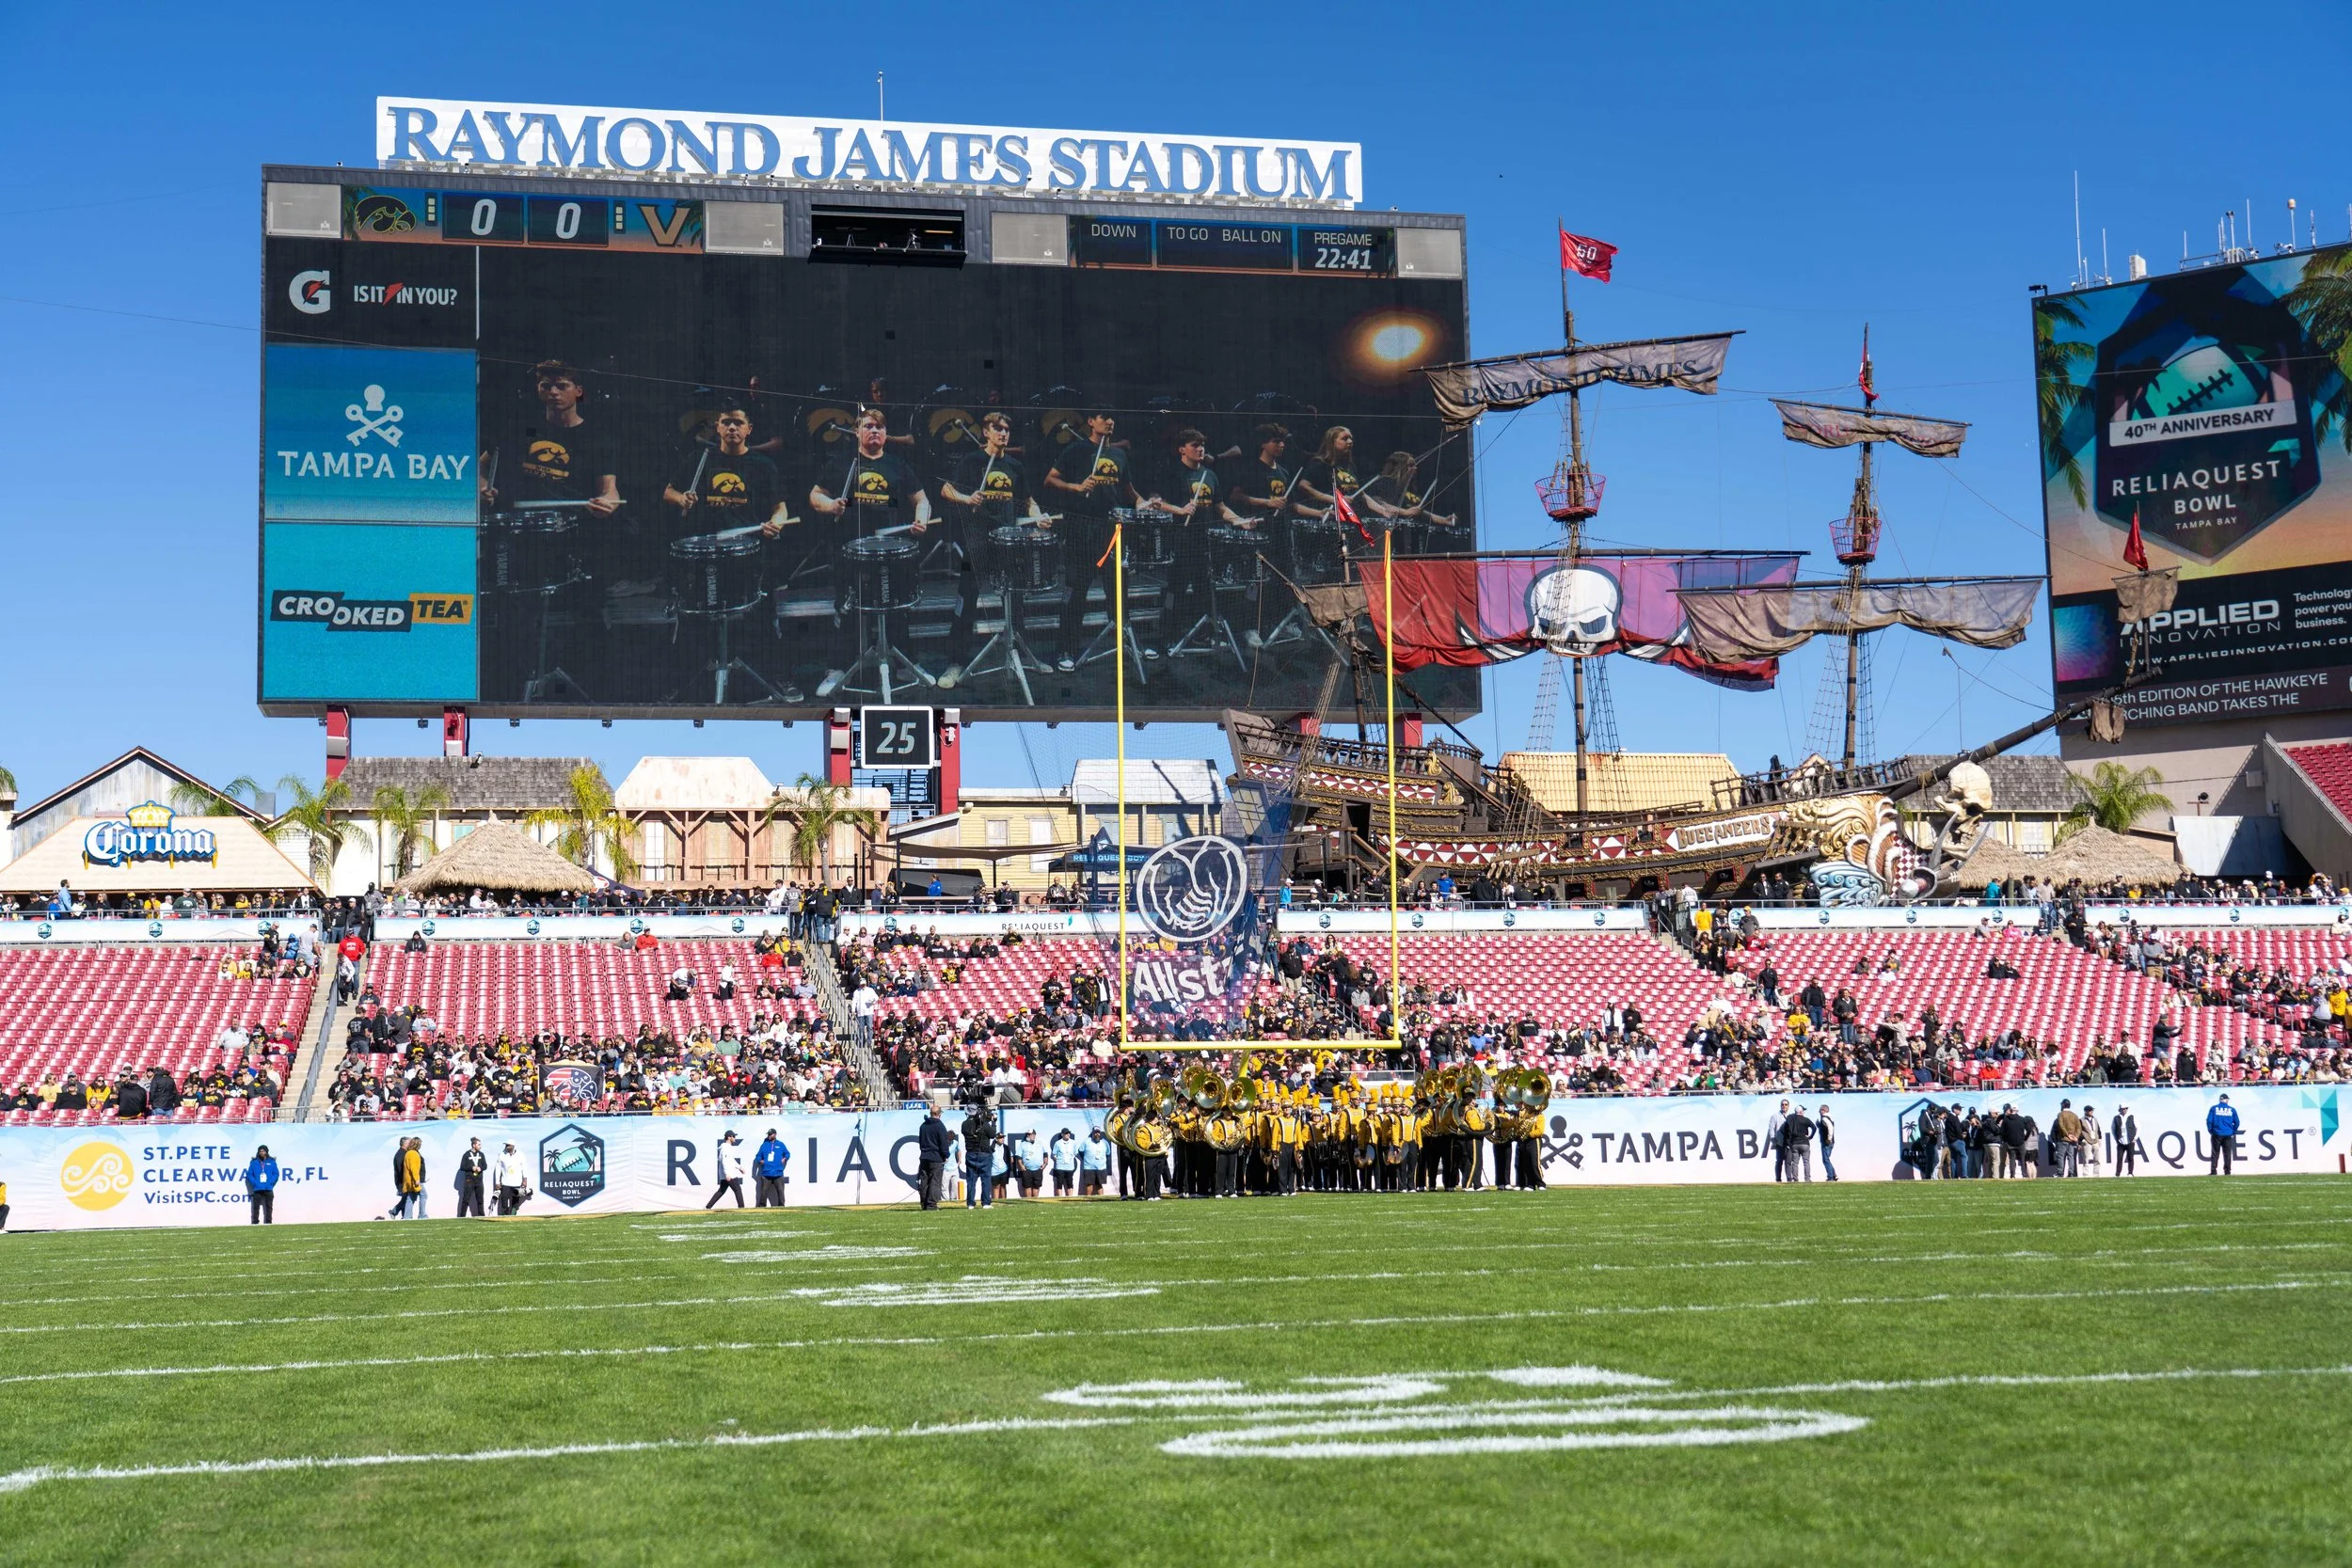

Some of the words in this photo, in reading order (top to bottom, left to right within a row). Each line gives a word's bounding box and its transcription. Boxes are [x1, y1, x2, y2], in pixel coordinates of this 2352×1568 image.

[387, 106, 781, 175] RAYMOND
[792, 126, 1031, 188] JAMES
[1049, 137, 1355, 202] STADIUM
[470, 198, 497, 237] 0
[556, 202, 580, 240] 0
[1090, 224, 1136, 239] DOWN
[1168, 227, 1186, 242] TO
[1189, 228, 1209, 242] GO
[1222, 229, 1258, 243] BALL
[1261, 230, 1282, 244] ON
[1313, 231, 1373, 246] PREGAME
[1314, 247, 1372, 271] 22:41
[1577, 244, 1597, 261] 50
[289, 270, 331, 314] G
[354, 285, 370, 303] IS
[371, 286, 385, 304] IT
[396, 286, 414, 305] IN
[416, 287, 458, 306] YOU?
[2124, 422, 2157, 438] 40TH
[2160, 408, 2275, 435] ANNIVERSARY
[278, 451, 395, 479] TAMPA
[407, 453, 469, 481] BAY
[2112, 459, 2280, 497] RELIAQUEST
[2174, 494, 2236, 515] BOWL
[2175, 520, 2212, 531] TAMPA
[2217, 516, 2237, 526] BAY
[2294, 588, 2352, 603] Technolog
[2295, 603, 2330, 617] power
[278, 596, 405, 626] CROOKED
[417, 599, 464, 618] TEA
[2121, 599, 2280, 635] APPLIED
[2296, 616, 2347, 629] business.
[2120, 621, 2281, 647] INNOVATION
[2125, 636, 2352, 667] W.APPLIEDINNOVATION.CO
[2138, 685, 2196, 702] EDITION
[2200, 683, 2219, 696] OF
[2222, 680, 2251, 694] THE
[2254, 673, 2328, 691] HAWKEYE
[2122, 705, 2175, 721] RCHING
[2178, 700, 2219, 716] BAND
[2221, 695, 2267, 710] TAKES
[2269, 692, 2299, 705] THE
[876, 721, 916, 754] 25
[86, 821, 214, 863] Corona
[1676, 816, 1771, 849] BUCCANEERS
[1001, 922, 1064, 930] REIAQUEST
[1592, 1130, 1724, 1164] TAMPA
[1736, 1128, 1777, 1160] BA
[544, 1180, 596, 1188] RELIAQUEST
